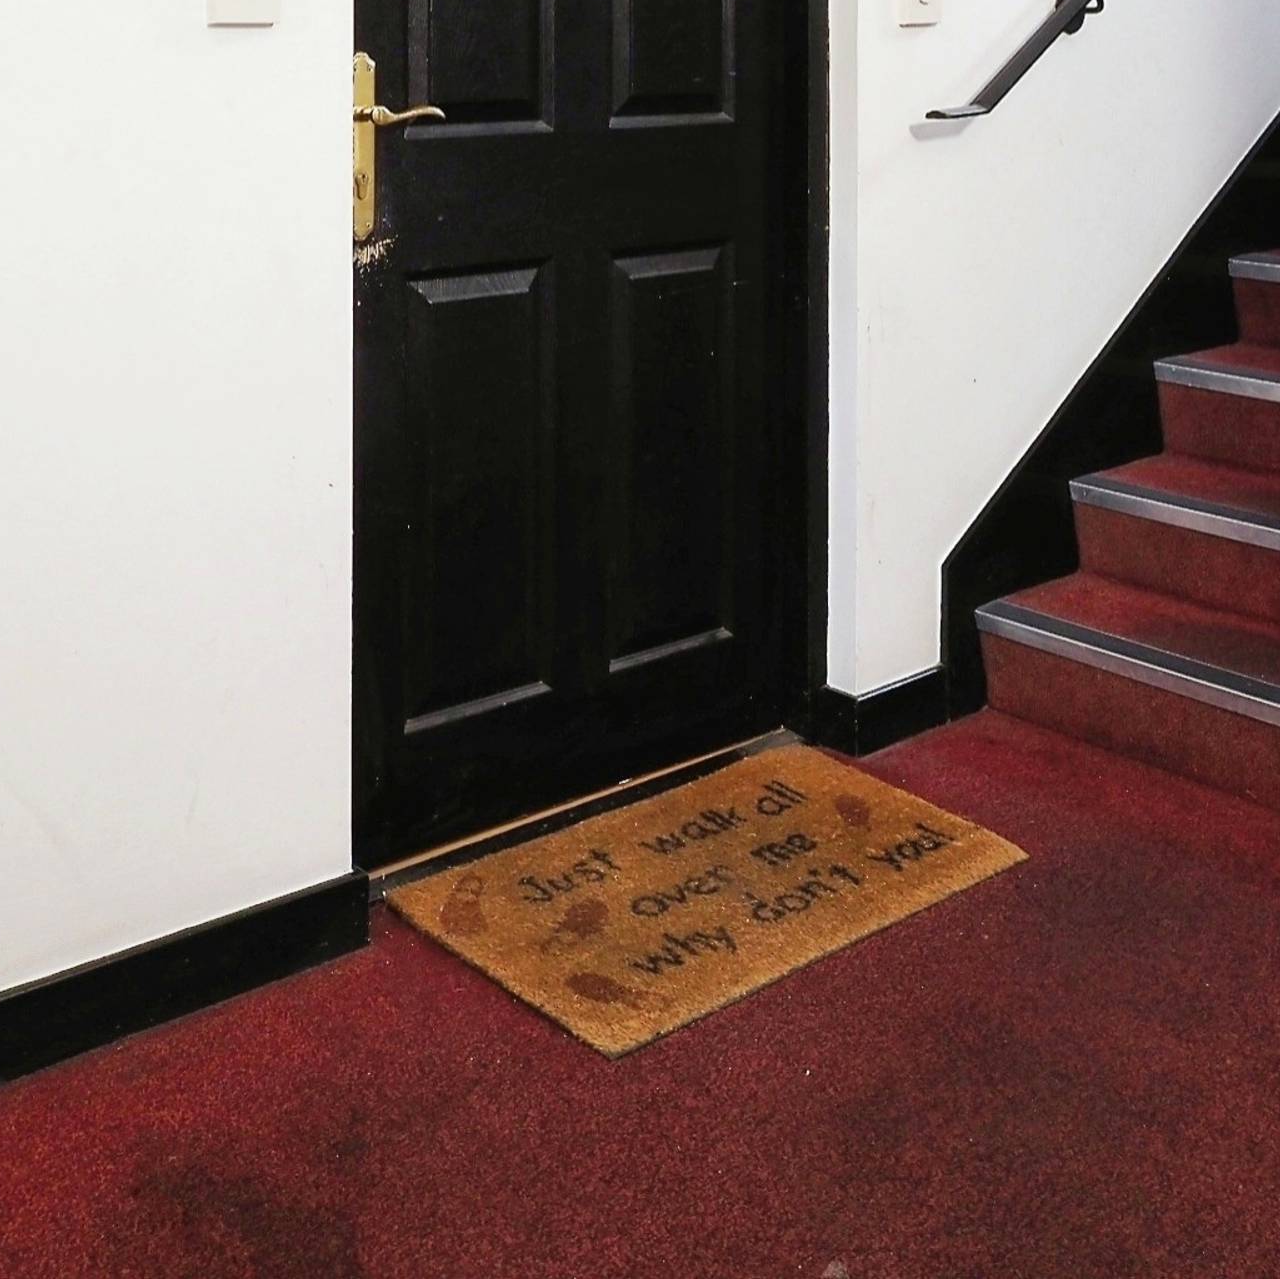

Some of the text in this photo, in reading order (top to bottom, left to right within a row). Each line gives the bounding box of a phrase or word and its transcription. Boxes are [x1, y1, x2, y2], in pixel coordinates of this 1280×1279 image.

[518, 780, 809, 904] Just walk all
[630, 864, 734, 917] over
[628, 925, 738, 975] why
[745, 863, 861, 922] don't
